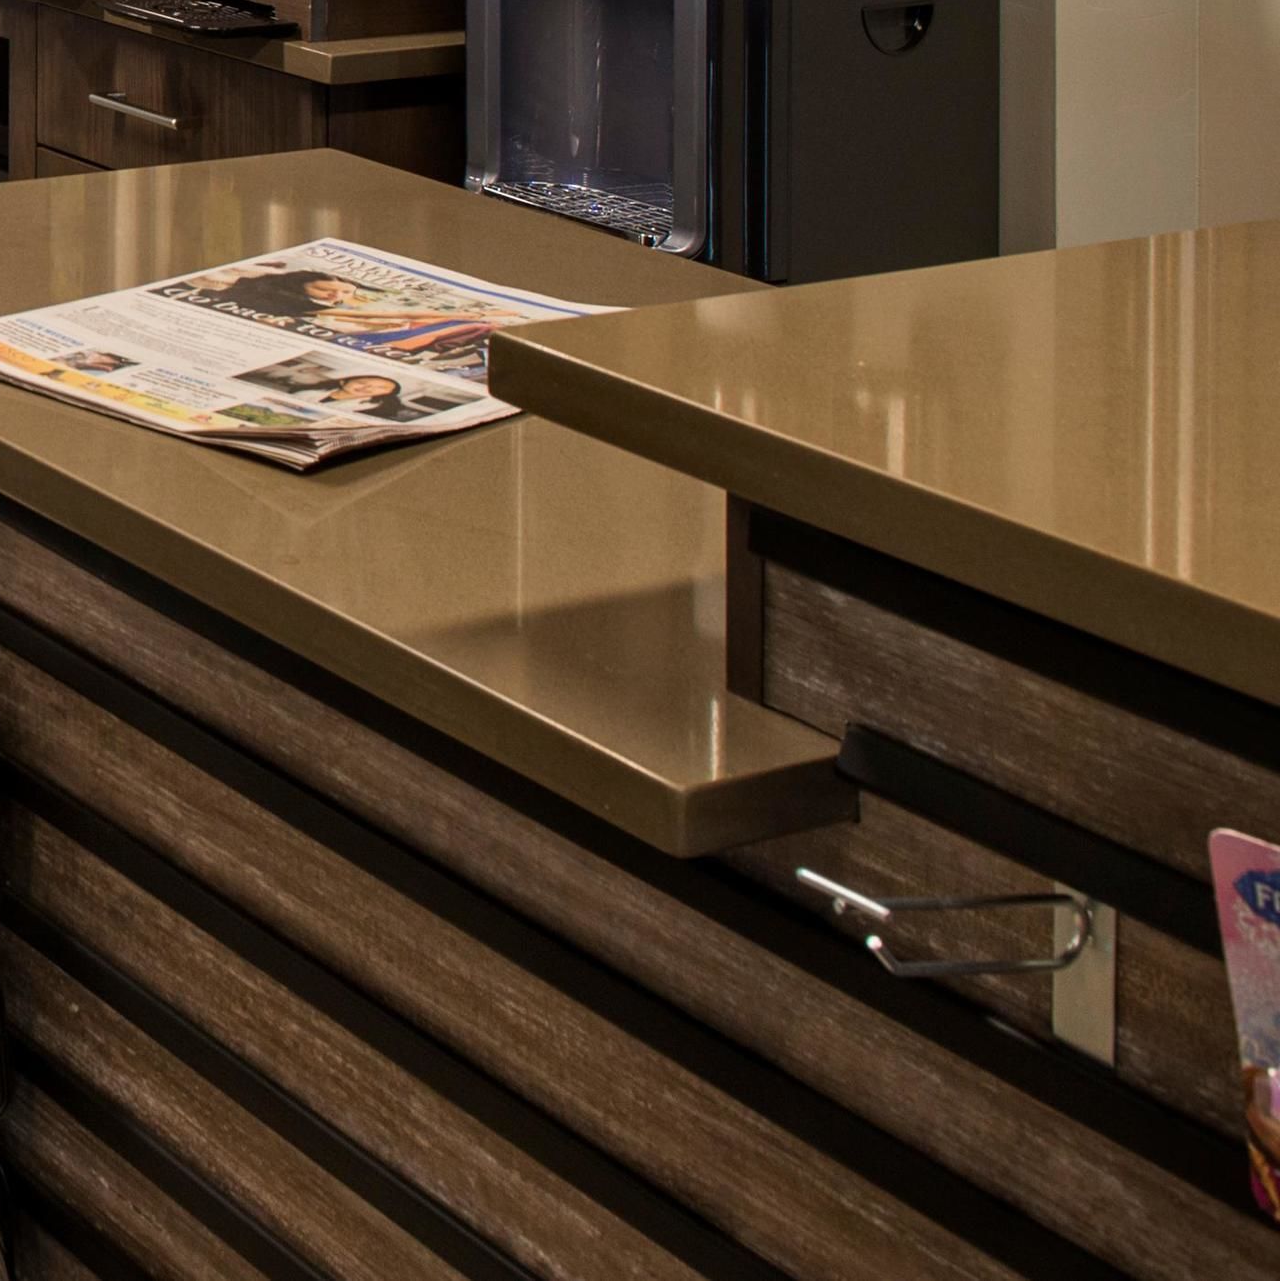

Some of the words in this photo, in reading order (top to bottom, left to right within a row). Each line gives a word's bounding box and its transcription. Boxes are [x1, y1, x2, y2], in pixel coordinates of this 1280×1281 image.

[162, 285, 213, 305] Go
[212, 299, 294, 328] back
[295, 321, 335, 339] to
